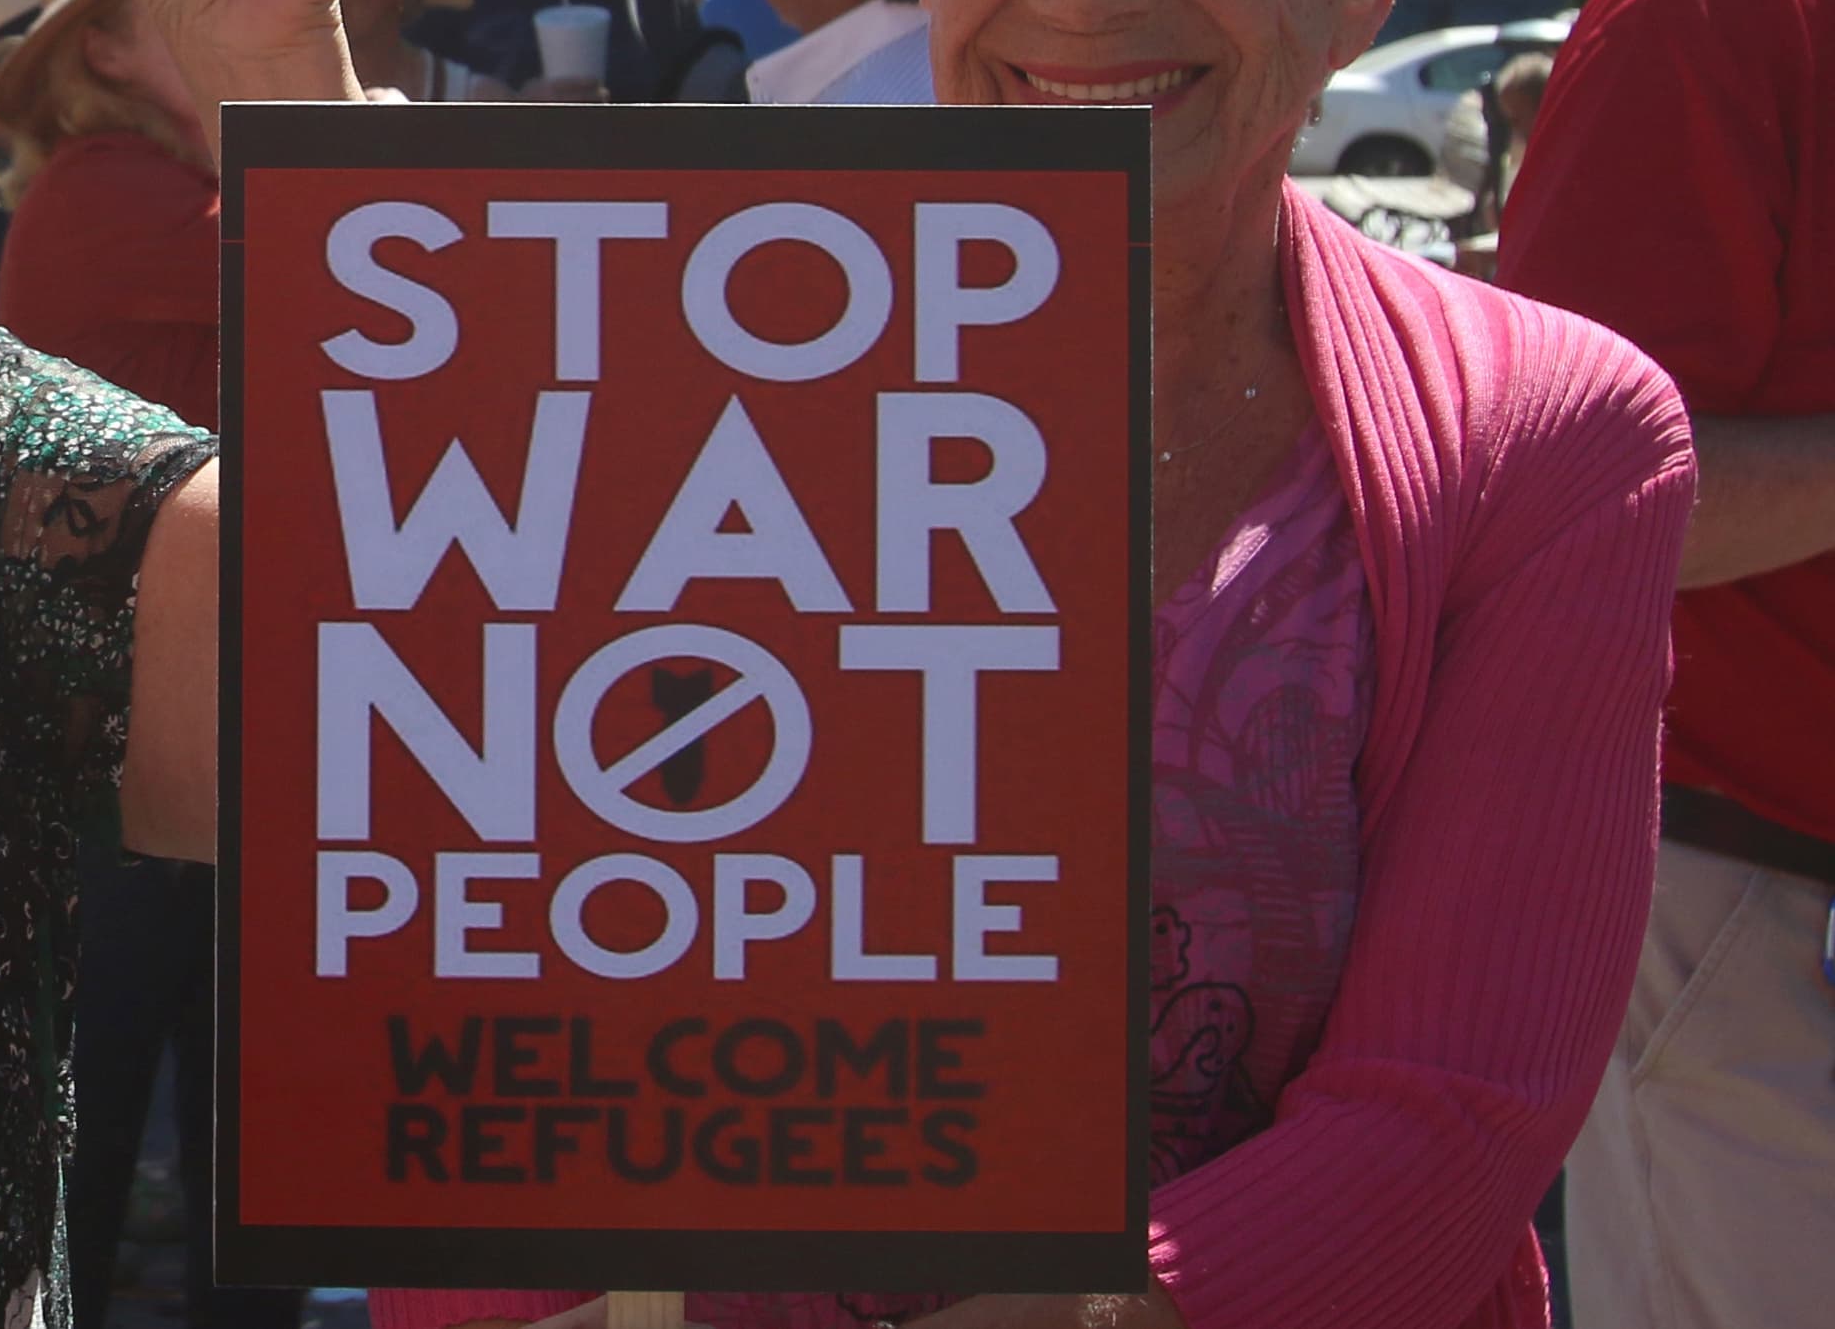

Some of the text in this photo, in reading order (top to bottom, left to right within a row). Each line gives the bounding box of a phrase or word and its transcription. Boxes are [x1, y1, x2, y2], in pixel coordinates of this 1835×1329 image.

[321, 202, 1059, 382] STOP
[321, 390, 1058, 613] WAR
[317, 622, 1060, 844] NOT
[316, 851, 1059, 981] PEOPLE
[386, 1015, 986, 1100] WELCOME
[384, 1103, 978, 1187] REFUGEES
